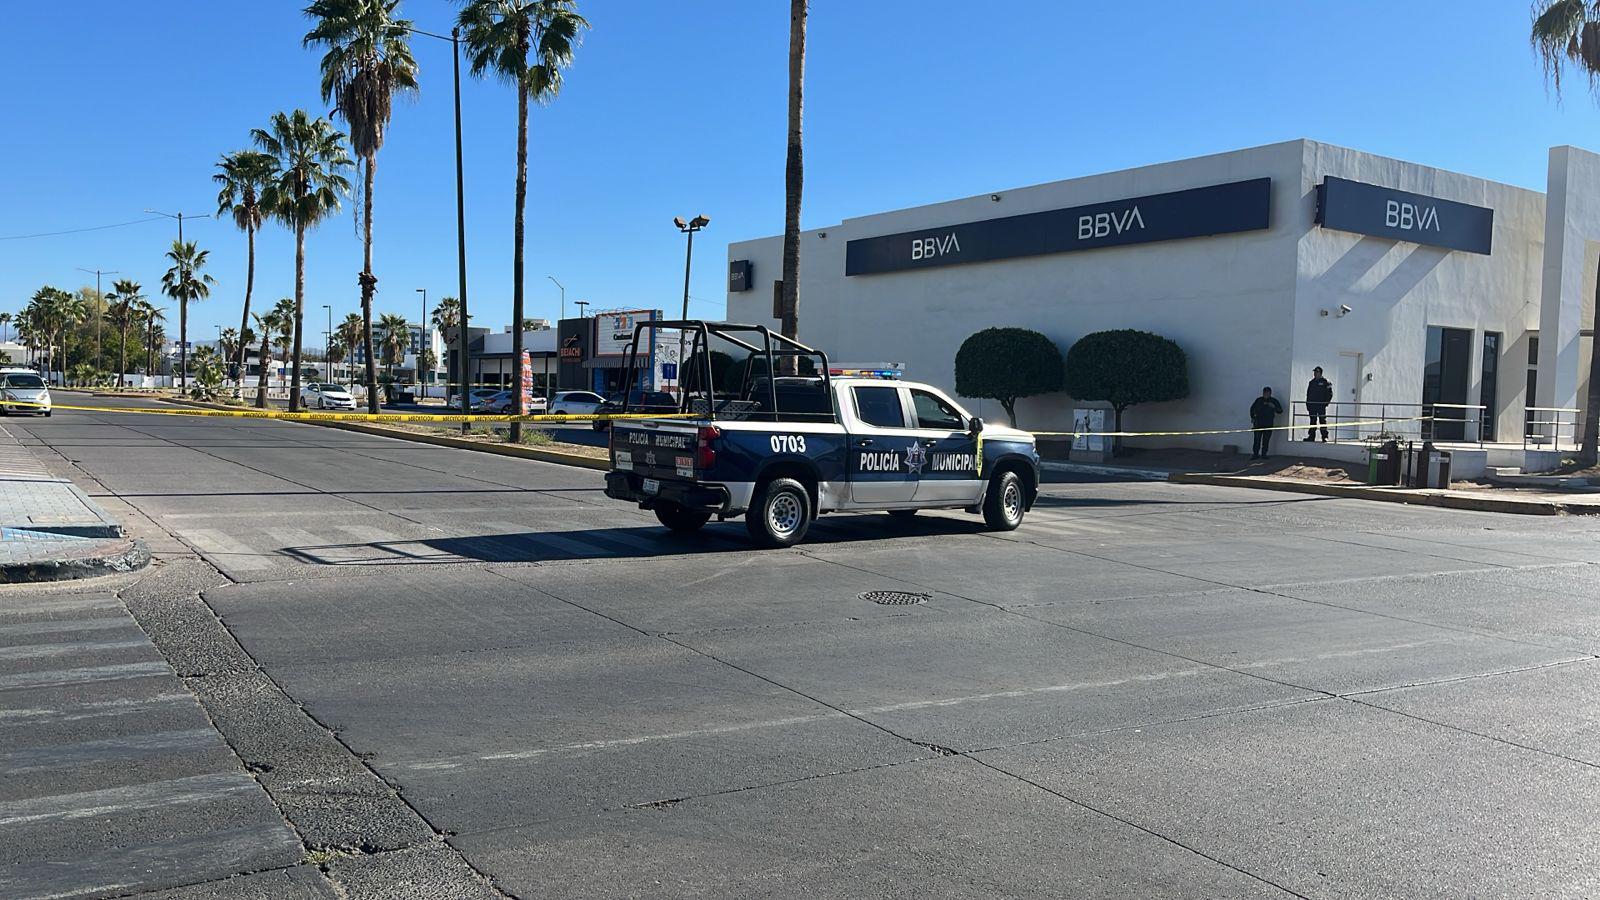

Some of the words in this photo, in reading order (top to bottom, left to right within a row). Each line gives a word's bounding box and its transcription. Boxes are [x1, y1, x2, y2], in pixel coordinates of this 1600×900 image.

[1078, 206, 1145, 240] BBVA
[1385, 200, 1440, 232] BBVA
[911, 232, 961, 260] BBVA
[731, 271, 745, 281] BBVA
[629, 430, 648, 445] POLICÍA
[656, 435, 686, 448] MUNICIPAL
[770, 435, 806, 453] 0703
[860, 448, 899, 471] POLICÍA
